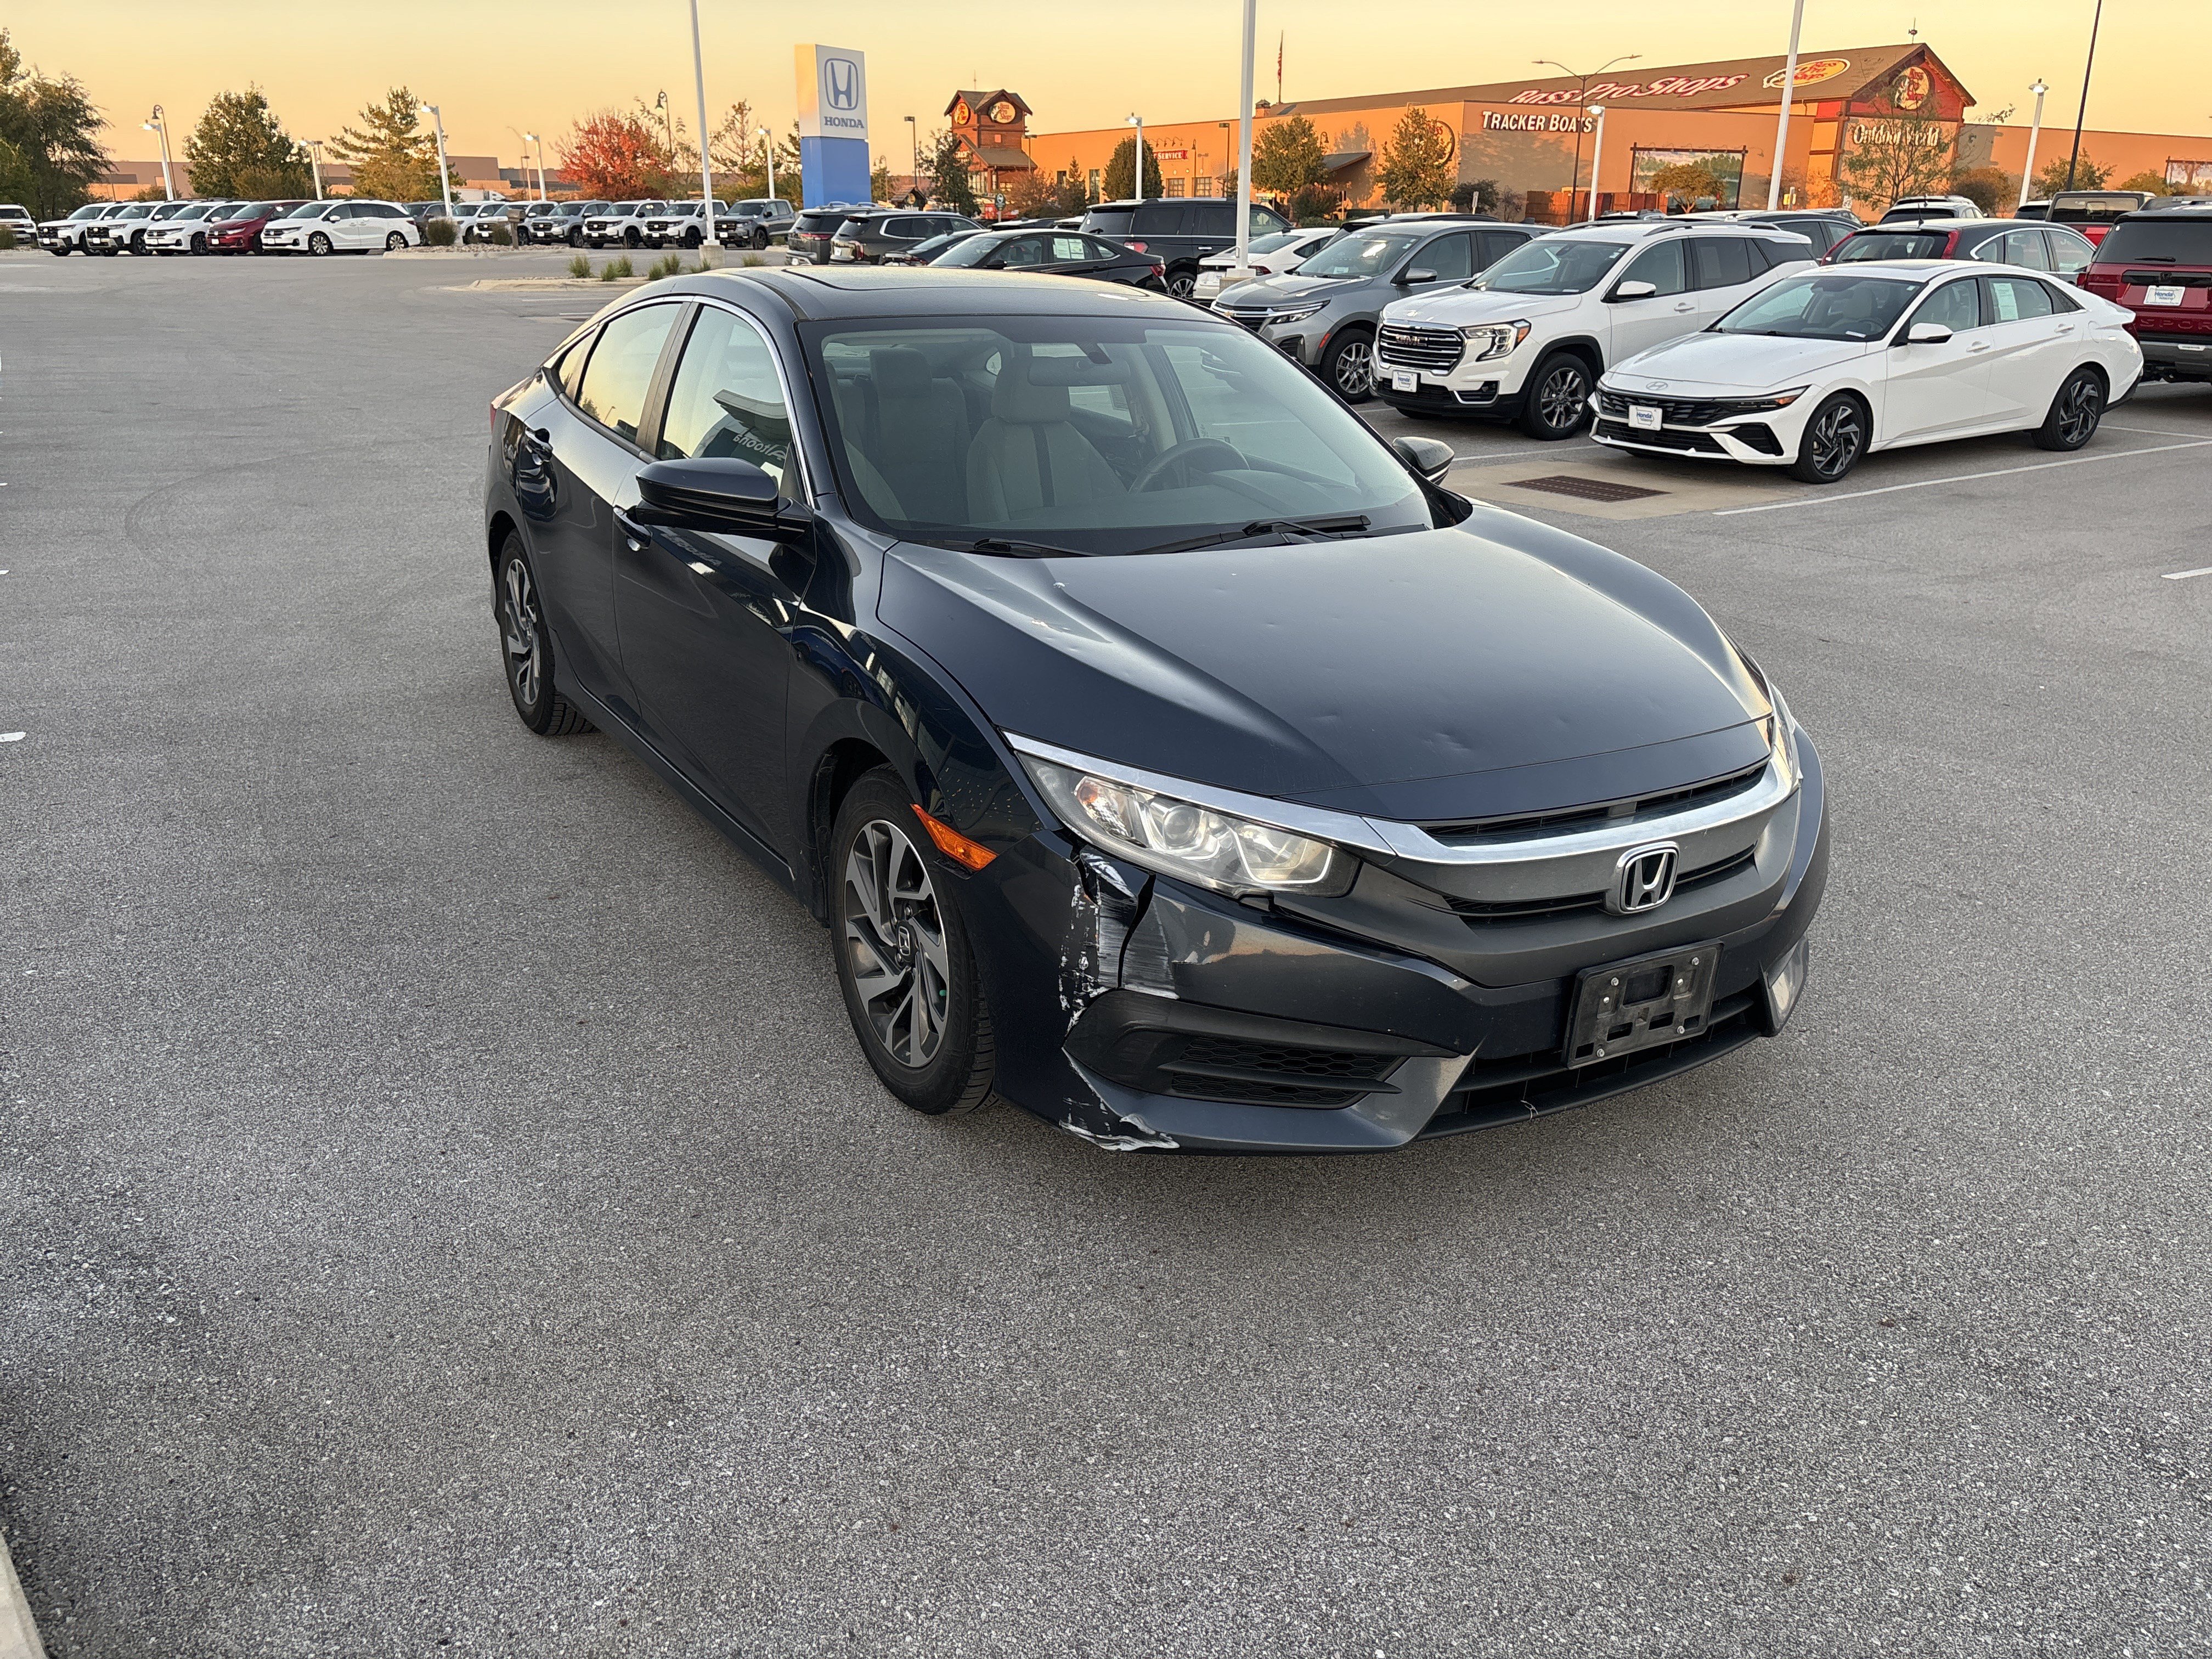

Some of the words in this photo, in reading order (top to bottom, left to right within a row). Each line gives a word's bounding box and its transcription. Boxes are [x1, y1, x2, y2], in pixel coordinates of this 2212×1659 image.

[1630, 74, 1750, 98] Shops
[824, 116, 865, 128] HONDA
[1482, 111, 1546, 131] TRACKER
[1396, 335, 1427, 346] GMC
